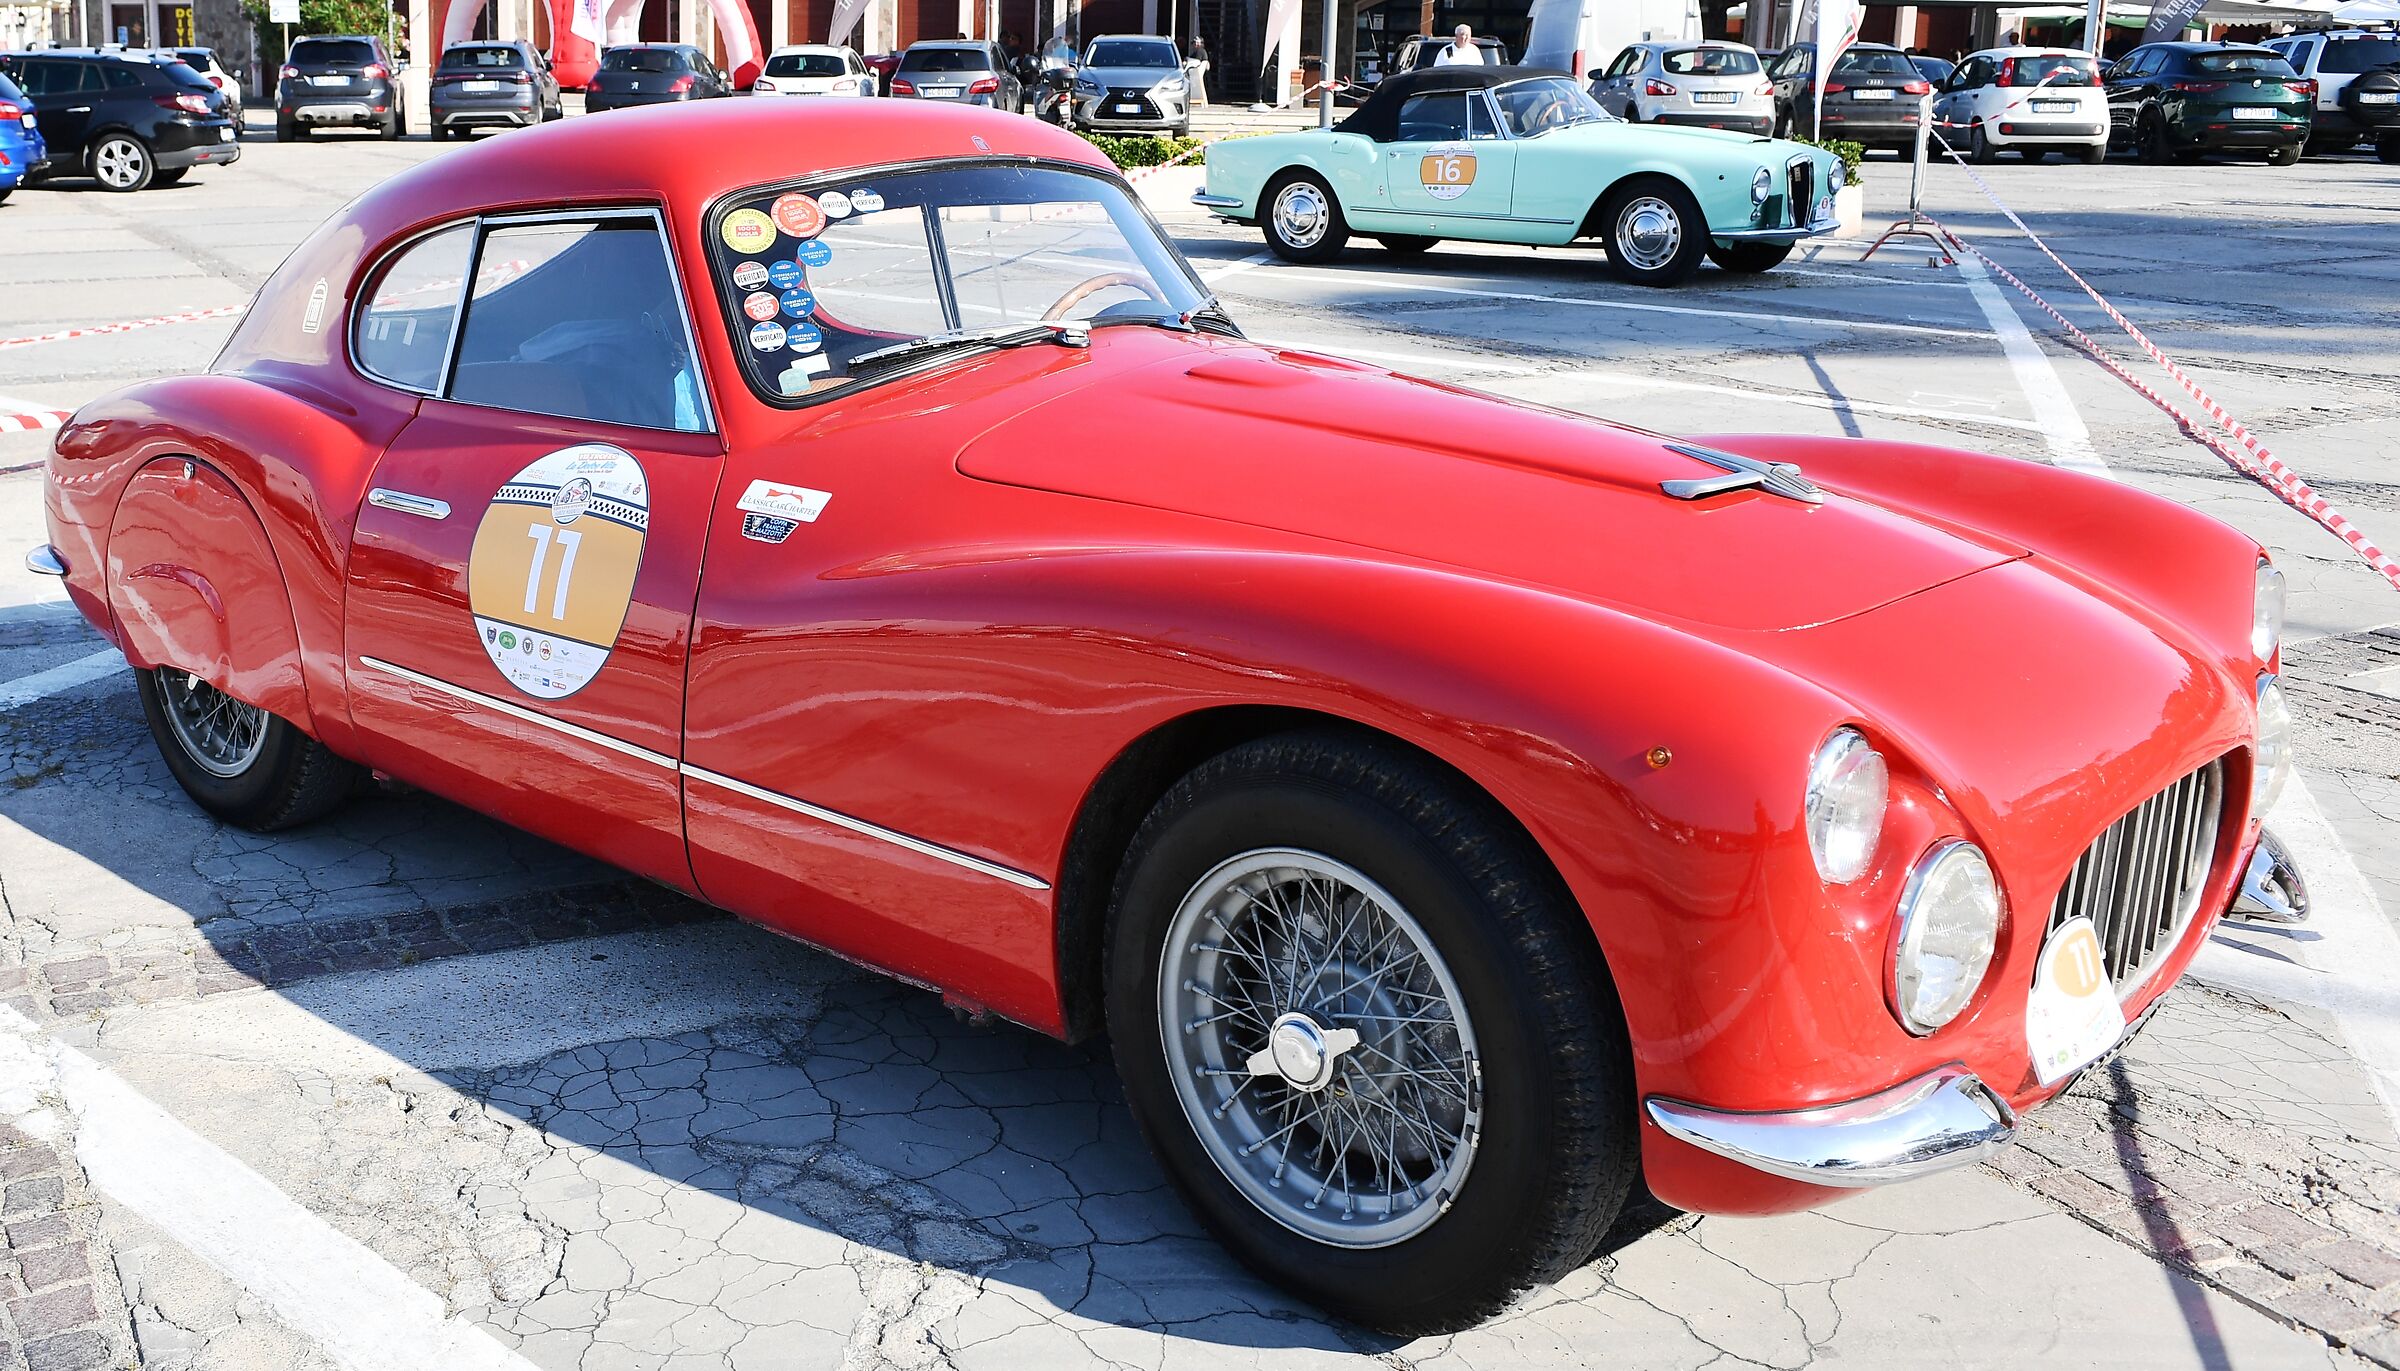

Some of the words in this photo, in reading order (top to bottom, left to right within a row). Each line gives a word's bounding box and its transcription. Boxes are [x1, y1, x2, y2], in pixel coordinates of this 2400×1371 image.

[2150, 17, 2168, 32] LA
[1435, 159, 1461, 182] 16
[736, 270, 767, 284] VERIFICATO
[754, 332, 784, 342] VERIFICATO
[524, 522, 583, 620] 11
[2068, 937, 2096, 988] 11
